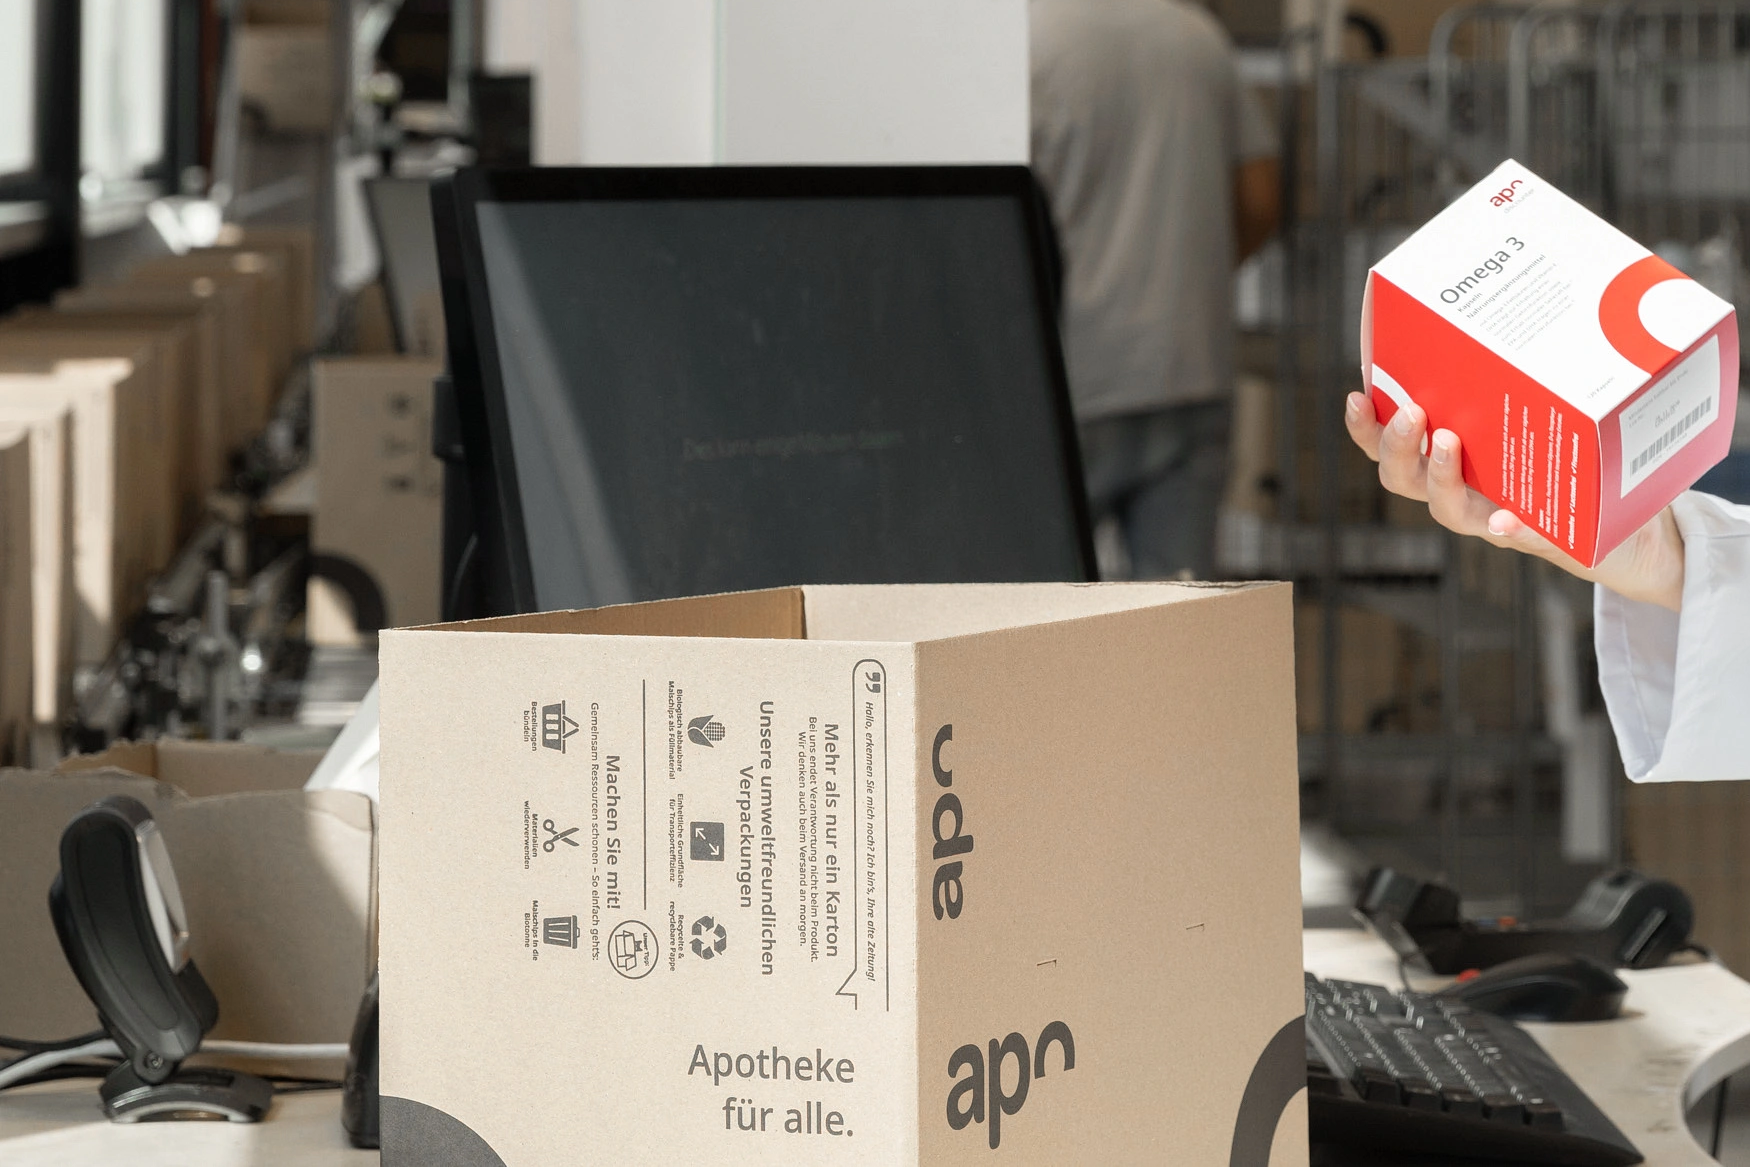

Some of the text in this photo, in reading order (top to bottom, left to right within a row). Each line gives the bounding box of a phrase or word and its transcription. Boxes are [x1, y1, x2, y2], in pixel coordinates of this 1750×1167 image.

[1440, 237, 1524, 304] Omega 3
[1457, 293, 1482, 312] Kapseln
[530, 701, 538, 752] Bestellungen
[591, 702, 599, 761] Gemeinsam
[809, 717, 818, 732] Bei
[865, 702, 874, 729] Hallo,
[809, 755, 818, 784] endet
[865, 732, 874, 777] erkennen
[591, 764, 599, 820] Ressourcen
[866, 779, 875, 794] Sie
[808, 787, 818, 862] Verantwortung
[867, 796, 875, 820] mich
[592, 823, 600, 864] schonen
[606, 755, 621, 909] Machen Sie mit!
[736, 766, 755, 907] Verpackungen
[760, 701, 776, 975] Unsere umweltfreundlichen
[798, 731, 808, 946] Wir denken auch beim Versand an morgen.
[824, 724, 840, 956] Mehr als nur ein Karton
[867, 822, 875, 852] noch?
[810, 865, 819, 890] nicht
[867, 853, 875, 868] Ich
[592, 875, 600, 888] So
[592, 890, 600, 926] einfach
[811, 892, 819, 917] beim
[867, 897, 876, 918] Ihre
[811, 920, 819, 962] Produkt.
[867, 920, 876, 939] alte
[865, 941, 876, 982] Zeitung!
[688, 1045, 854, 1085] Apotheke
[723, 1097, 852, 1136] für alle.
